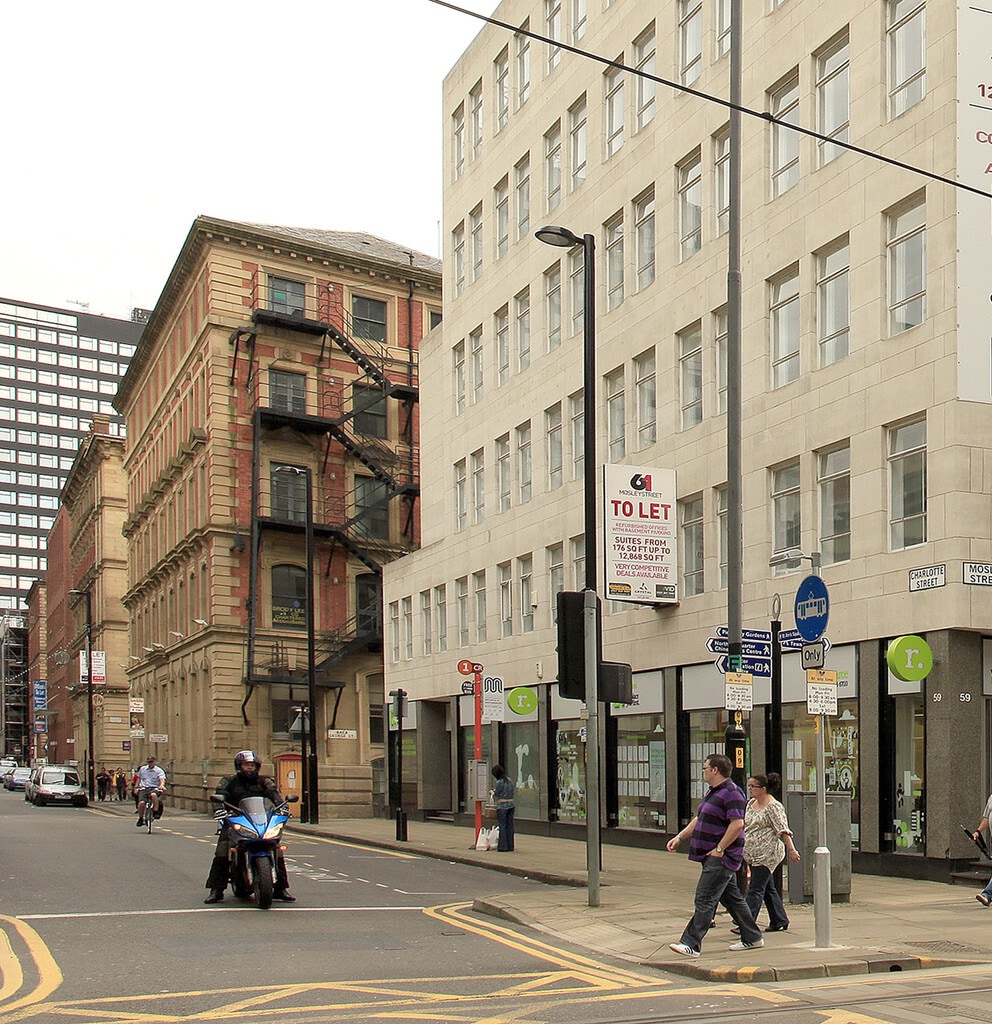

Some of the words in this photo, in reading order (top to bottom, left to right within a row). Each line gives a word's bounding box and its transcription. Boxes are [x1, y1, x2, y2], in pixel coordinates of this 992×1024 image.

[630, 473, 652, 491] 61
[611, 499, 633, 517] TO
[639, 502, 671, 520] LET
[615, 536, 641, 545] SUITES
[644, 538, 666, 547] FROM
[619, 552, 643, 561] 12,868
[630, 564, 670, 573] COMPETITIVE
[911, 566, 944, 580] CHARLOTTE
[637, 571, 669, 579] AVAILABLE
[916, 577, 938, 589] STREET
[746, 631, 766, 639] Gardens
[805, 649, 820, 662] Only
[462, 663, 469, 672] 1
[933, 693, 942, 702] 59
[960, 693, 971, 702] 59
